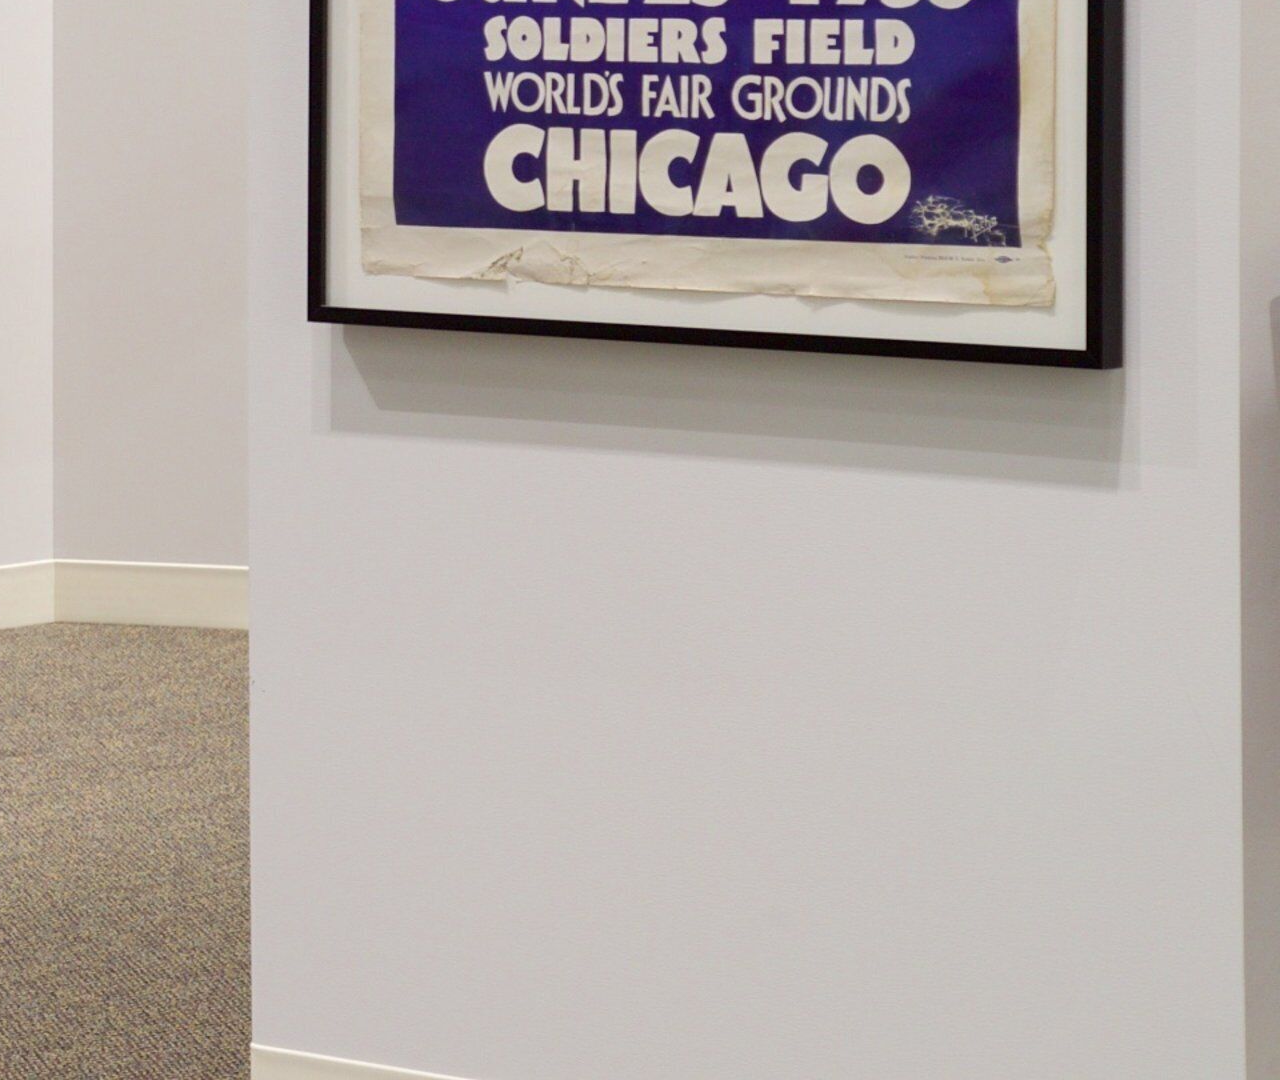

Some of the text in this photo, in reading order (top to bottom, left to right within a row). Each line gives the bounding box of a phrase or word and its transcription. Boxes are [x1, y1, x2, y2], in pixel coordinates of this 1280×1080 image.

[483, 15, 916, 66] SOLDIERS FIELD
[483, 71, 912, 124] WORLD'S FAIR GROUNDS
[483, 123, 912, 225] CHICAGO
